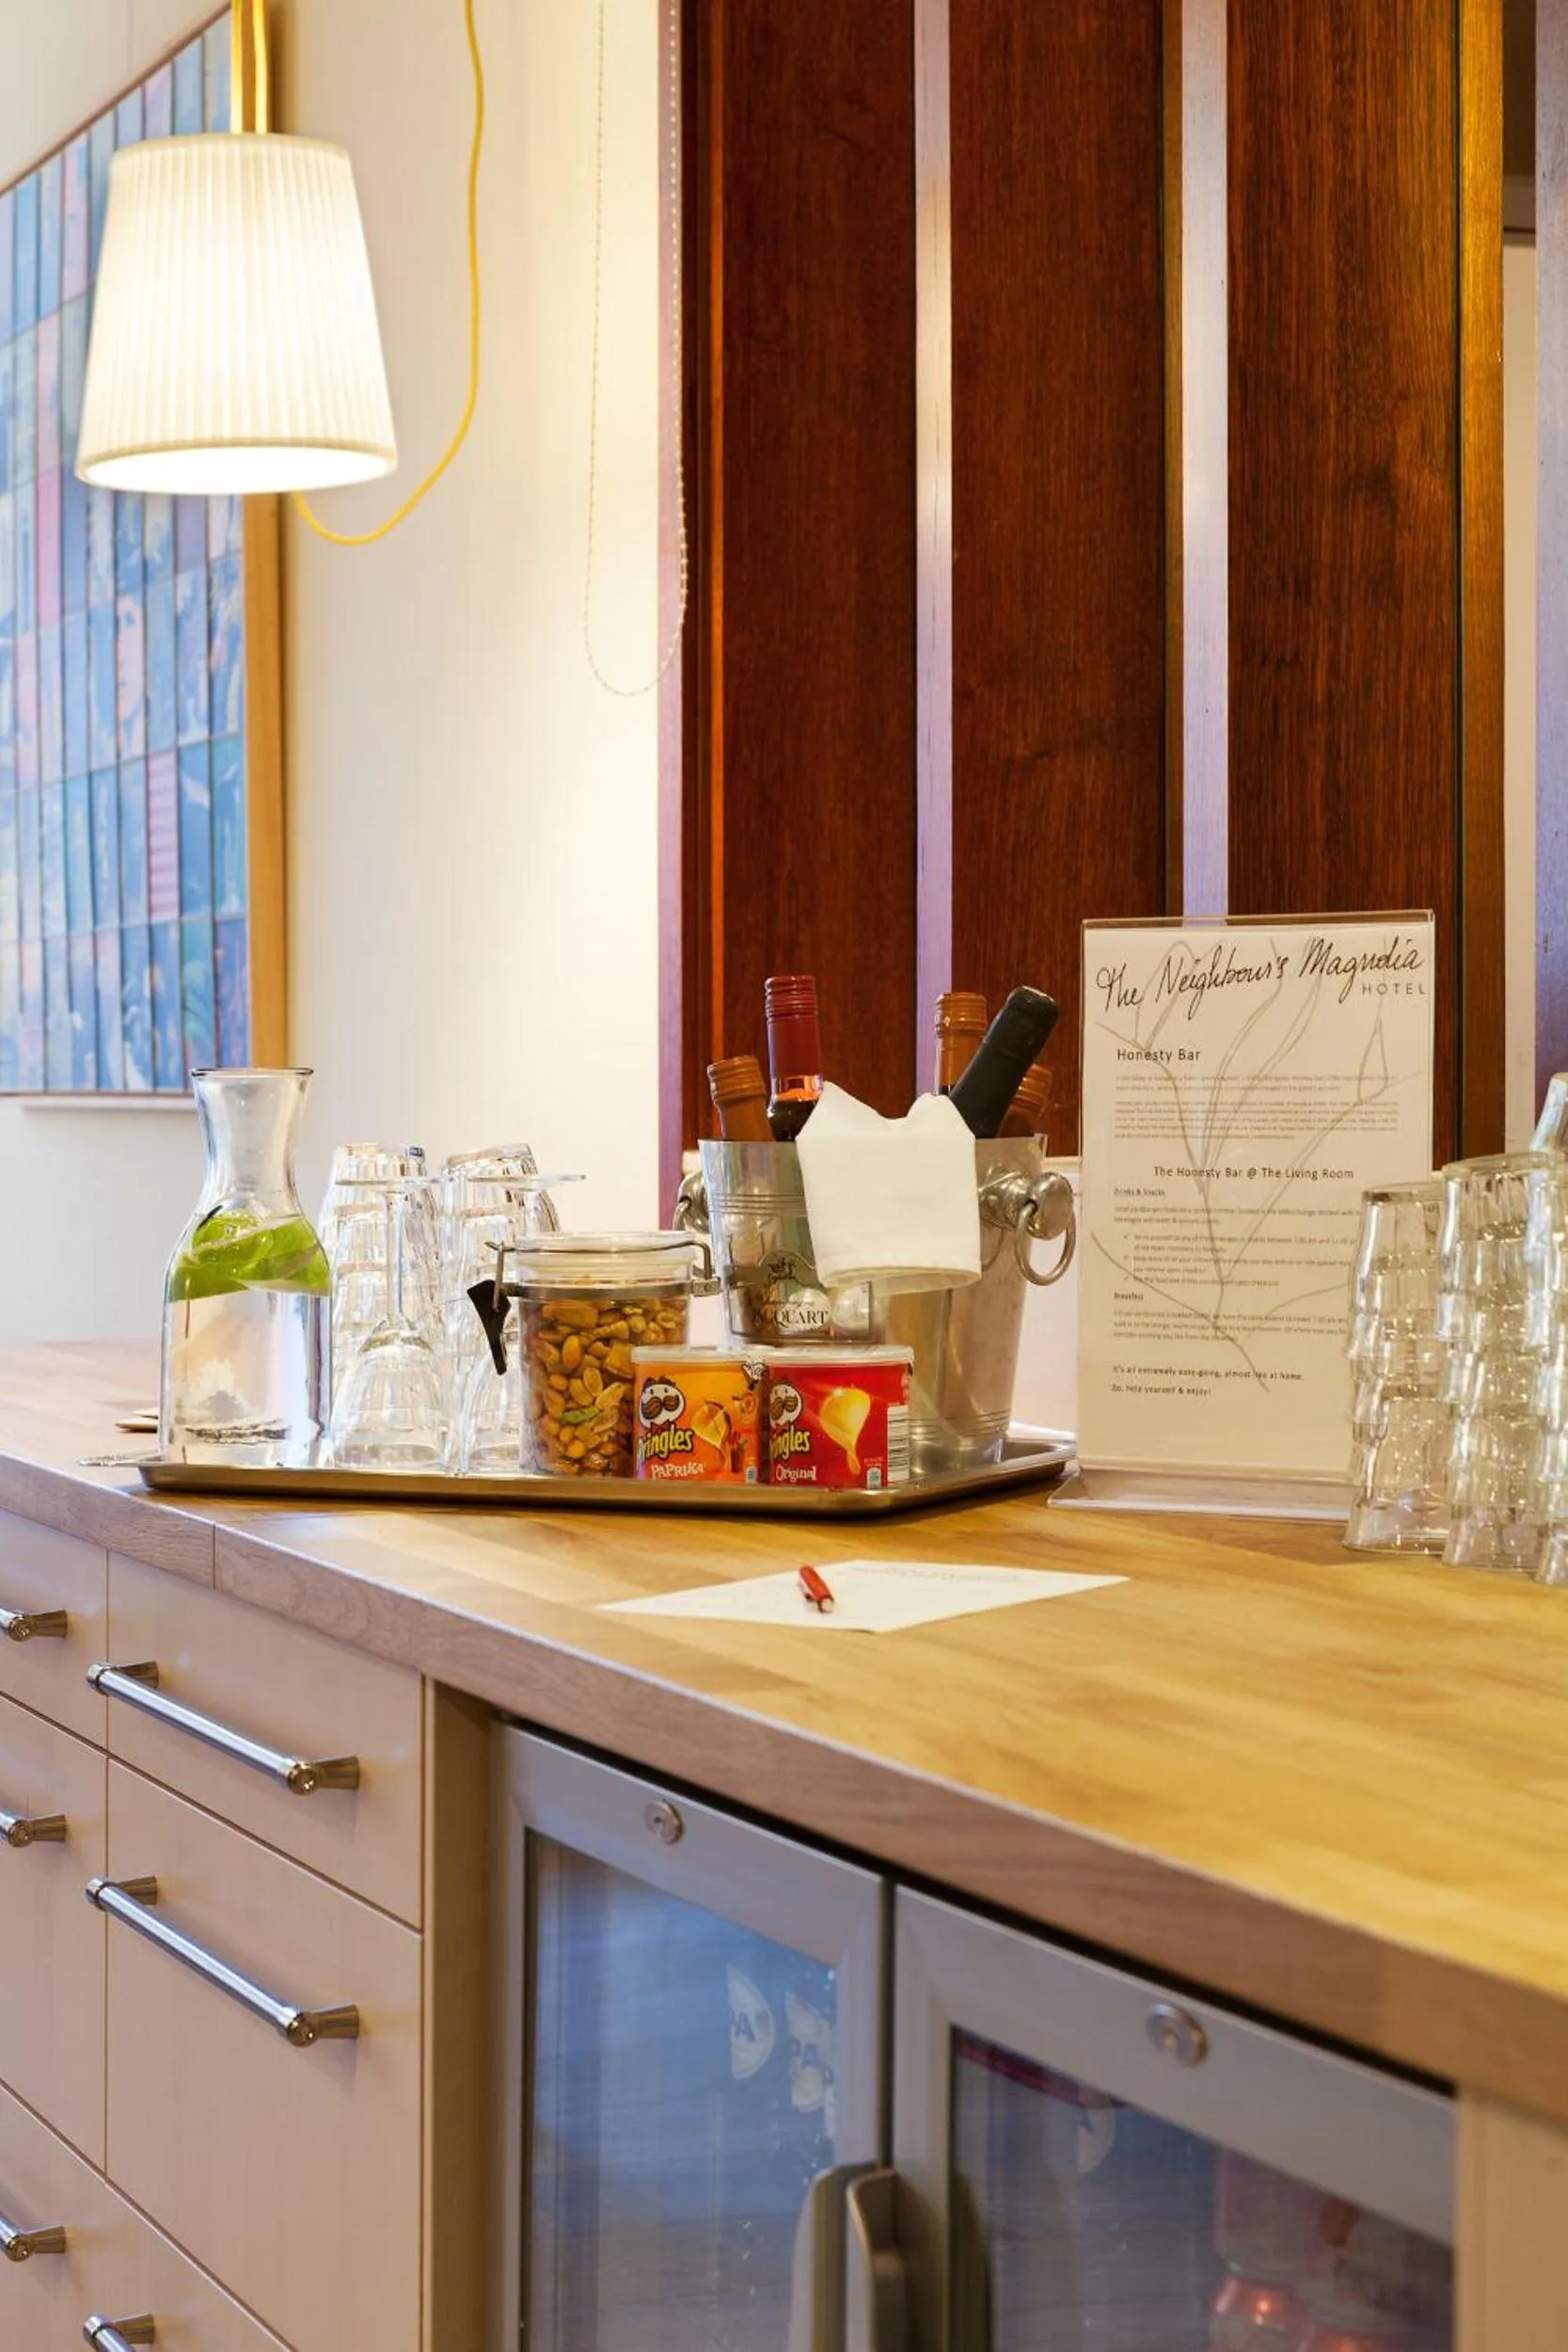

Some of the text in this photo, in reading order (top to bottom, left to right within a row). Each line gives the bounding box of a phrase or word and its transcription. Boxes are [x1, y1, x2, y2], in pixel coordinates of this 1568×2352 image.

[1096, 936, 1424, 1020] The Neighbour's Magnolia
[1362, 983, 1426, 995] HOTEL
[1117, 1048, 1200, 1065] Honesty Bar
[1154, 1166, 1354, 1180] The Honesty Bar @ The Living Room
[650, 1462, 705, 1480] PAPRIKA
[776, 1464, 817, 1482] Original
